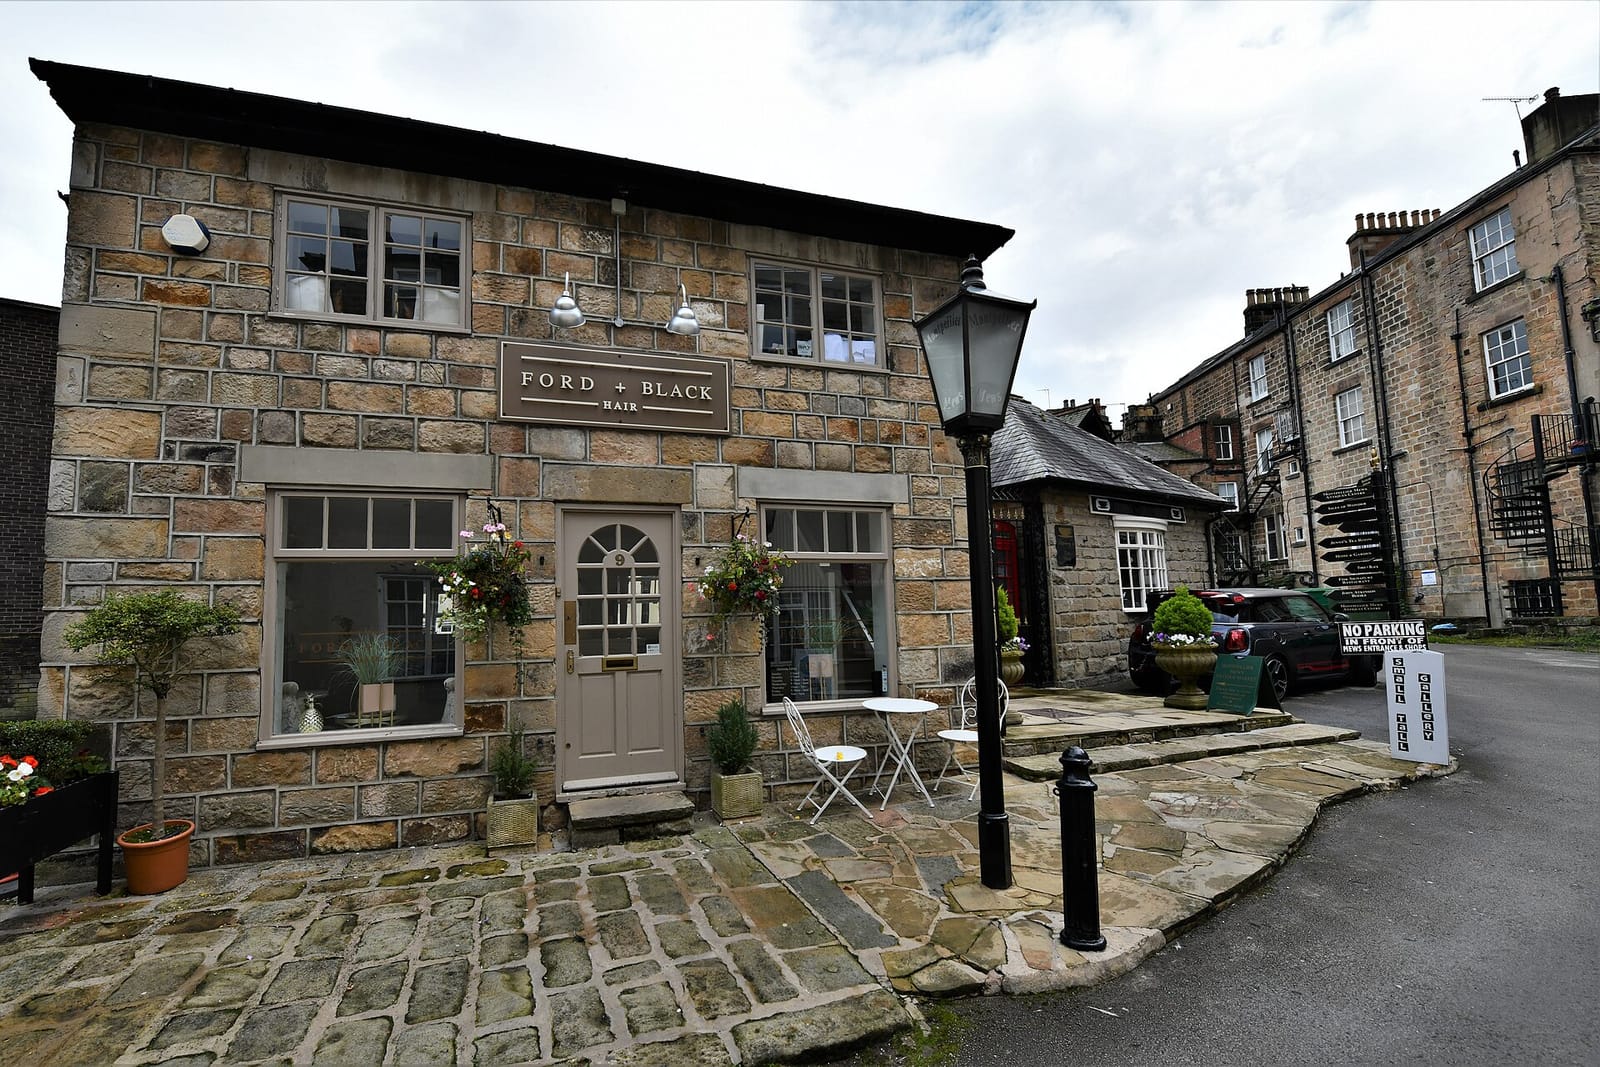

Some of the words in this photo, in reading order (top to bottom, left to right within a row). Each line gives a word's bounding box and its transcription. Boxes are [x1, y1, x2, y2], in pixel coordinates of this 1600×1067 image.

[521, 371, 595, 391] FORD
[641, 381, 712, 400] BLACK
[603, 400, 638, 412] HAIR
[615, 554, 625, 566] 9
[1342, 624, 1362, 637] NO
[1364, 623, 1425, 636] PARKING
[1345, 638, 1359, 646] IN
[1363, 644, 1398, 652] ENTRANCE
